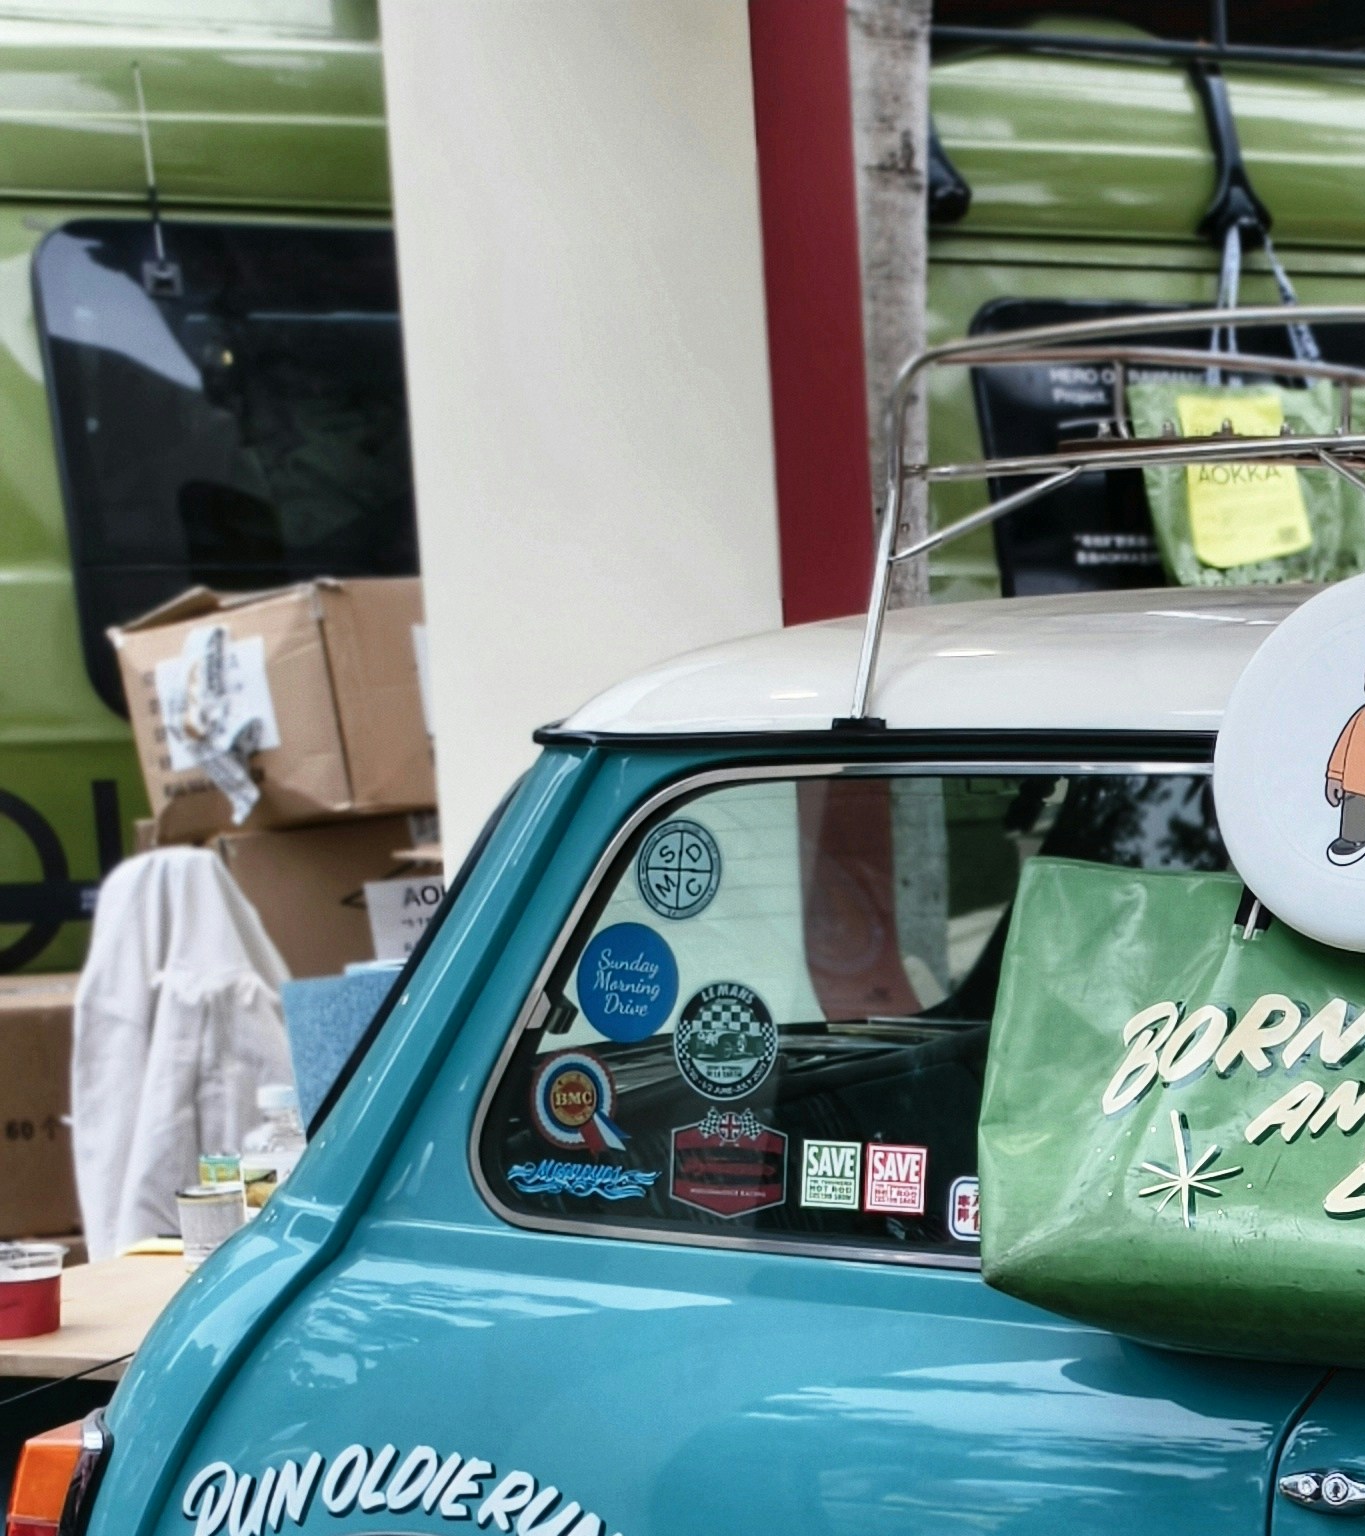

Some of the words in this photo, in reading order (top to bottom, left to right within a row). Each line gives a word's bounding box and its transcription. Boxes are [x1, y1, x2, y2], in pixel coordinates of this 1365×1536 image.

[1198, 463, 1283, 486] AOKKA
[659, 844, 676, 864] S
[685, 843, 703, 864] D
[655, 873, 677, 898] M
[685, 877, 703, 898] C
[598, 947, 660, 980] Sunday
[593, 969, 661, 1002] Morning
[716, 983, 756, 1005] MANS
[603, 992, 649, 1017] Drive
[554, 1090, 594, 1106] BMC
[807, 1145, 856, 1178] SAVE
[872, 1151, 921, 1183] SAVE
[321, 1442, 494, 1520] OLDIE
